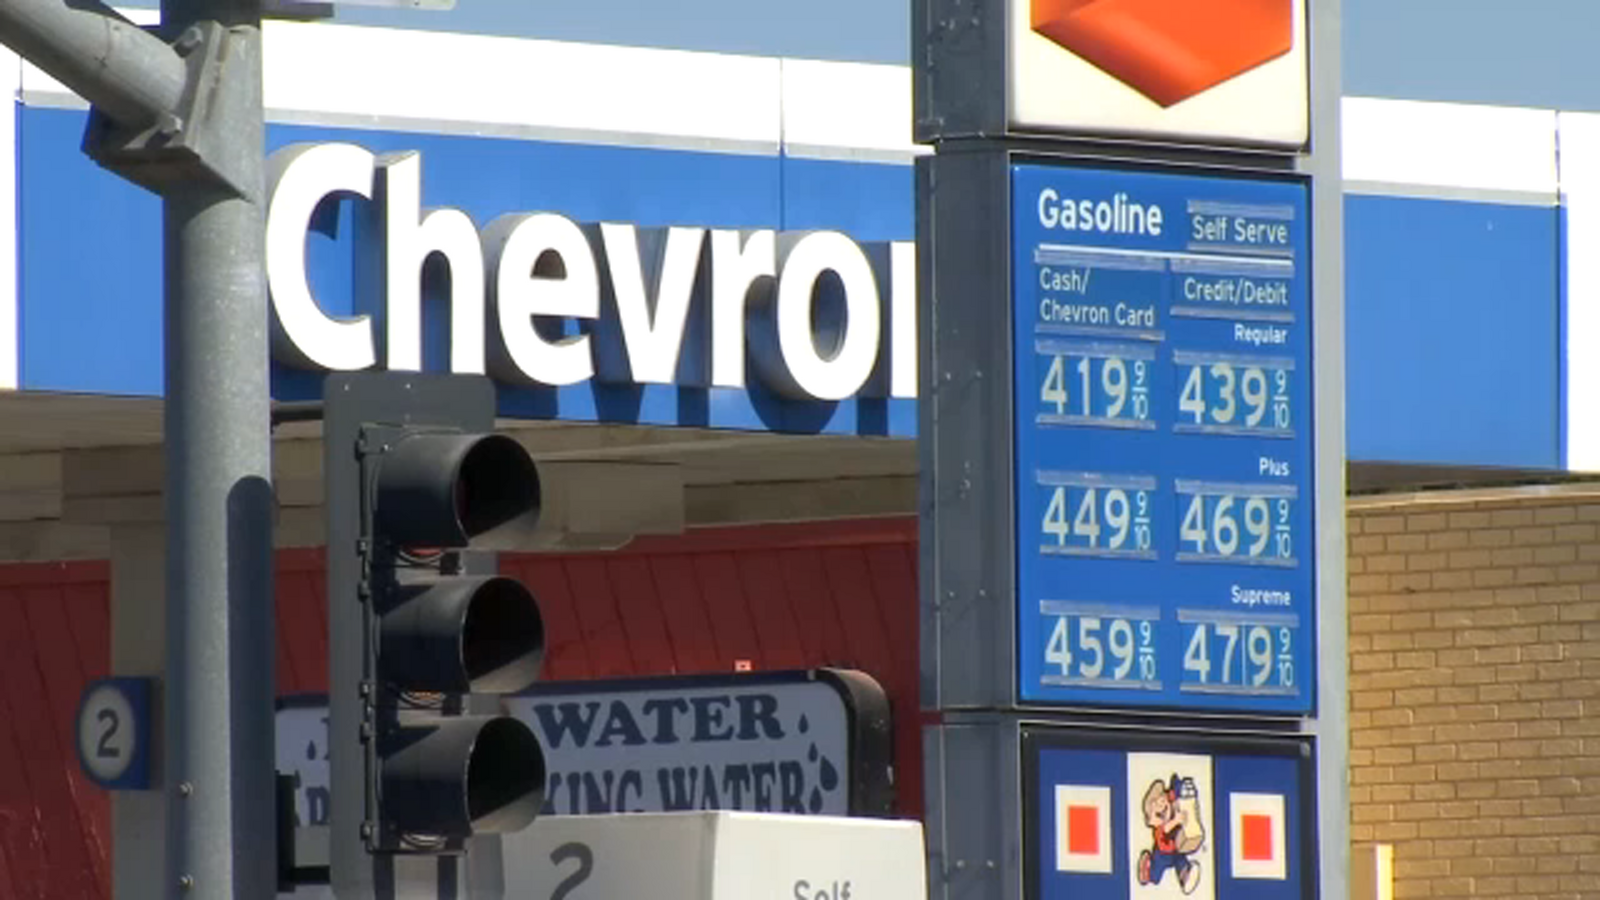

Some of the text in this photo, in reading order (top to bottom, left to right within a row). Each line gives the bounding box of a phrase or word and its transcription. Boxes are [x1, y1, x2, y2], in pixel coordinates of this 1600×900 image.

[1038, 189, 1163, 236] Gasoline
[1192, 215, 1288, 244] Self Serve
[1039, 267, 1091, 295] Cash/
[1184, 277, 1288, 306] Credit/Debit
[1040, 298, 1155, 327] Chevron Card
[1234, 324, 1288, 346] Regular
[1040, 355, 1128, 418] 419
[1178, 362, 1267, 427] 439
[1259, 456, 1290, 477] Plus
[1041, 486, 1131, 550] 449
[1179, 495, 1270, 557] 469
[1231, 585, 1291, 608] Supreme
[1044, 616, 1135, 681] 459
[1183, 622, 1273, 688] 479
[97, 708, 120, 758] 2
[533, 694, 786, 750] WATER
[657, 760, 806, 815] WATER
[550, 841, 594, 900] 2
